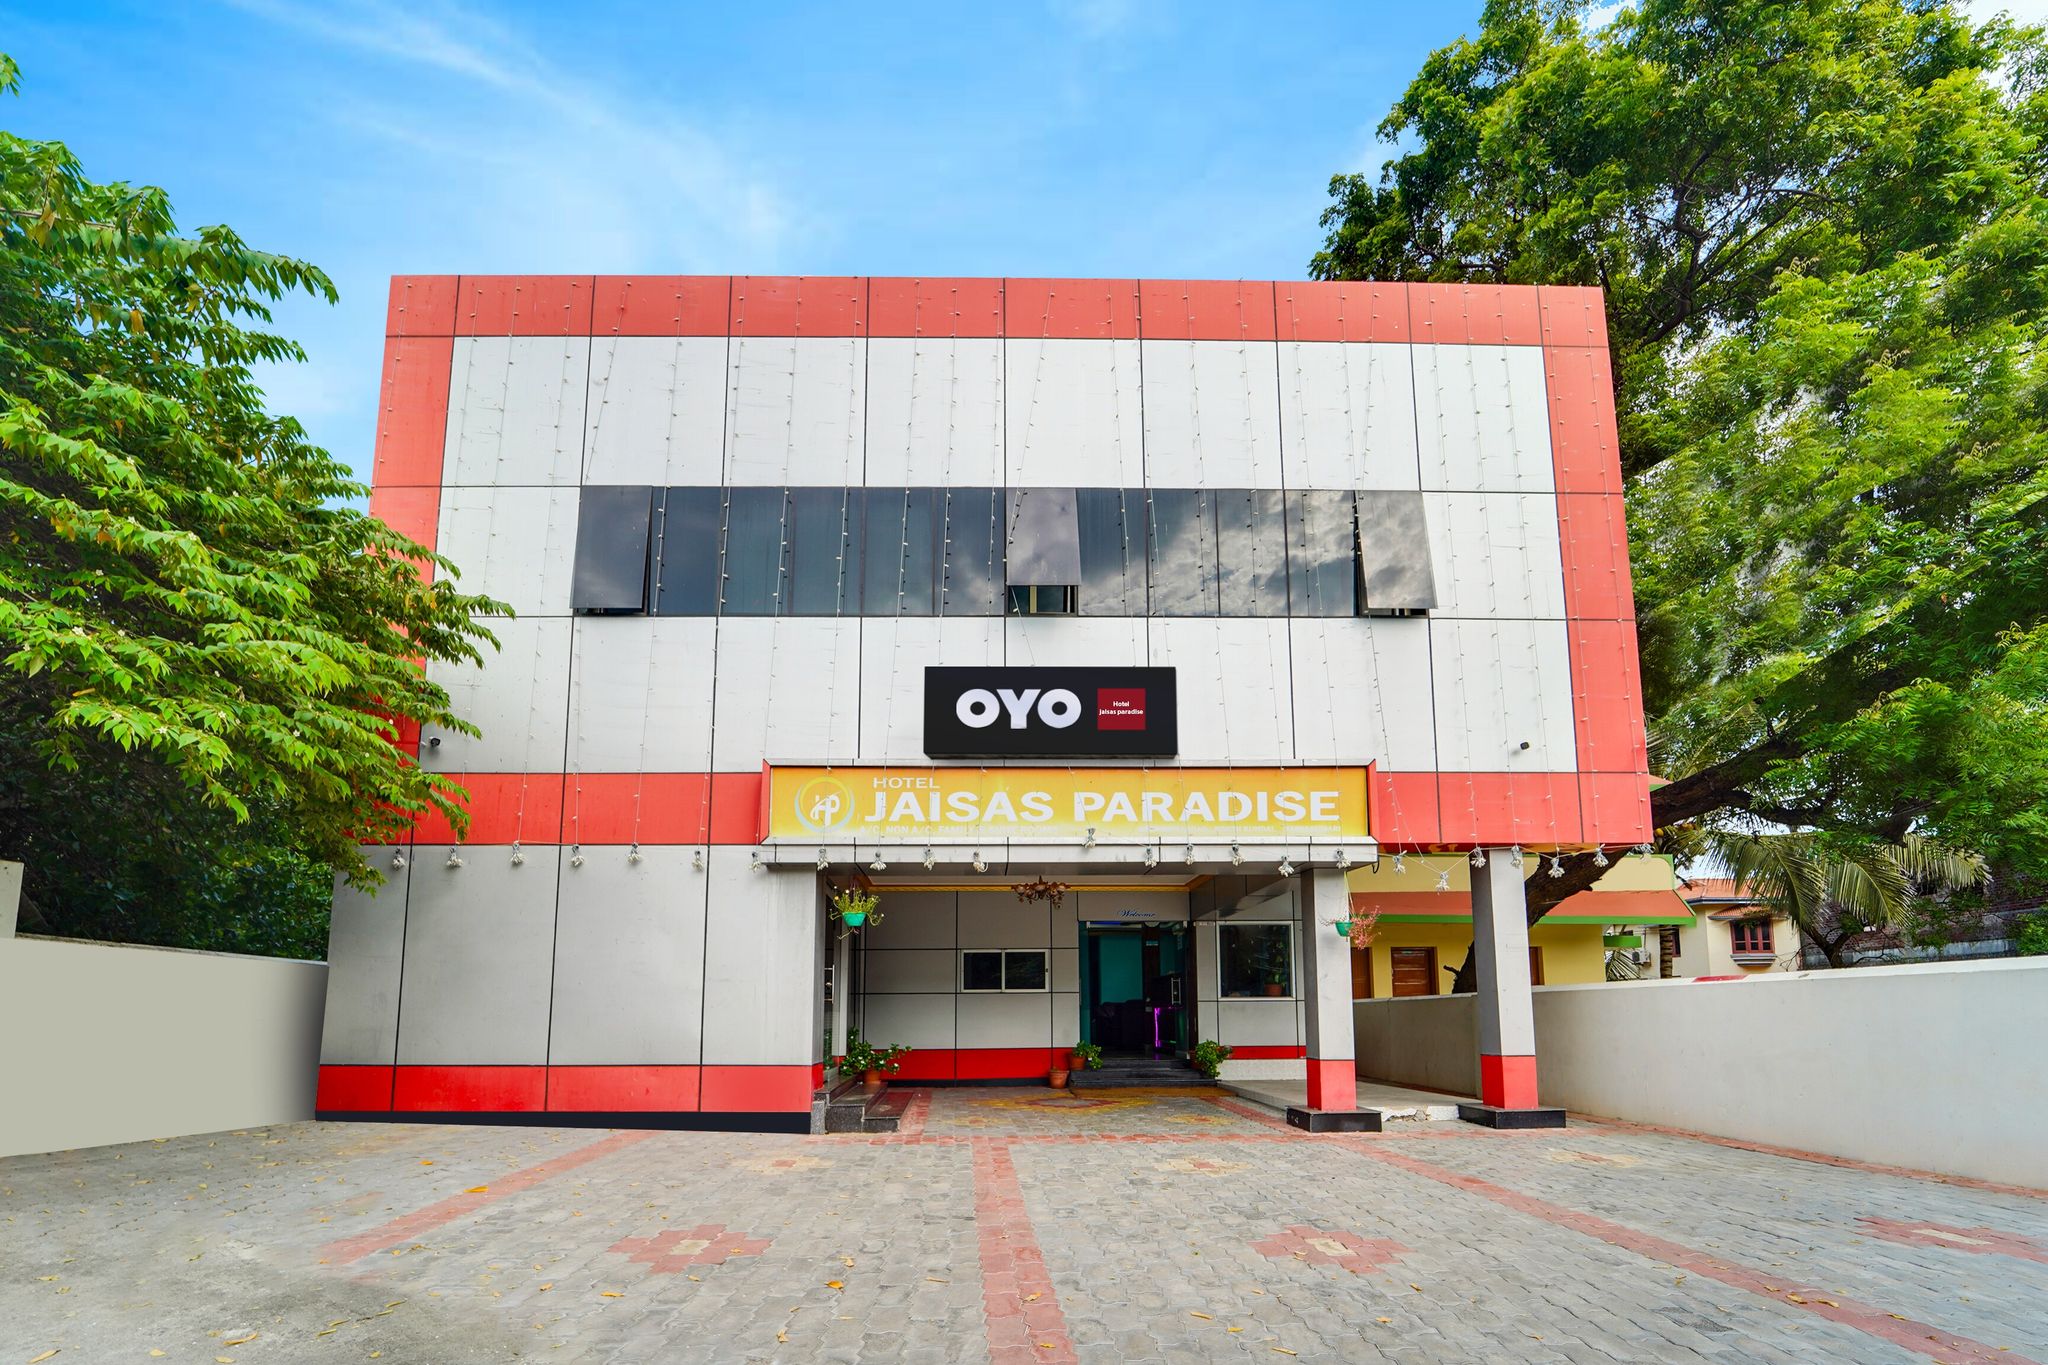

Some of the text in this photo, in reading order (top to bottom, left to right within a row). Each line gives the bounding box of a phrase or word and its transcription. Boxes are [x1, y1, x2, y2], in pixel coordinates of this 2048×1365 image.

[956, 688, 1082, 729] OYO
[872, 777, 940, 788] HOTEL
[864, 791, 1341, 822] JAISAS PARADISE
